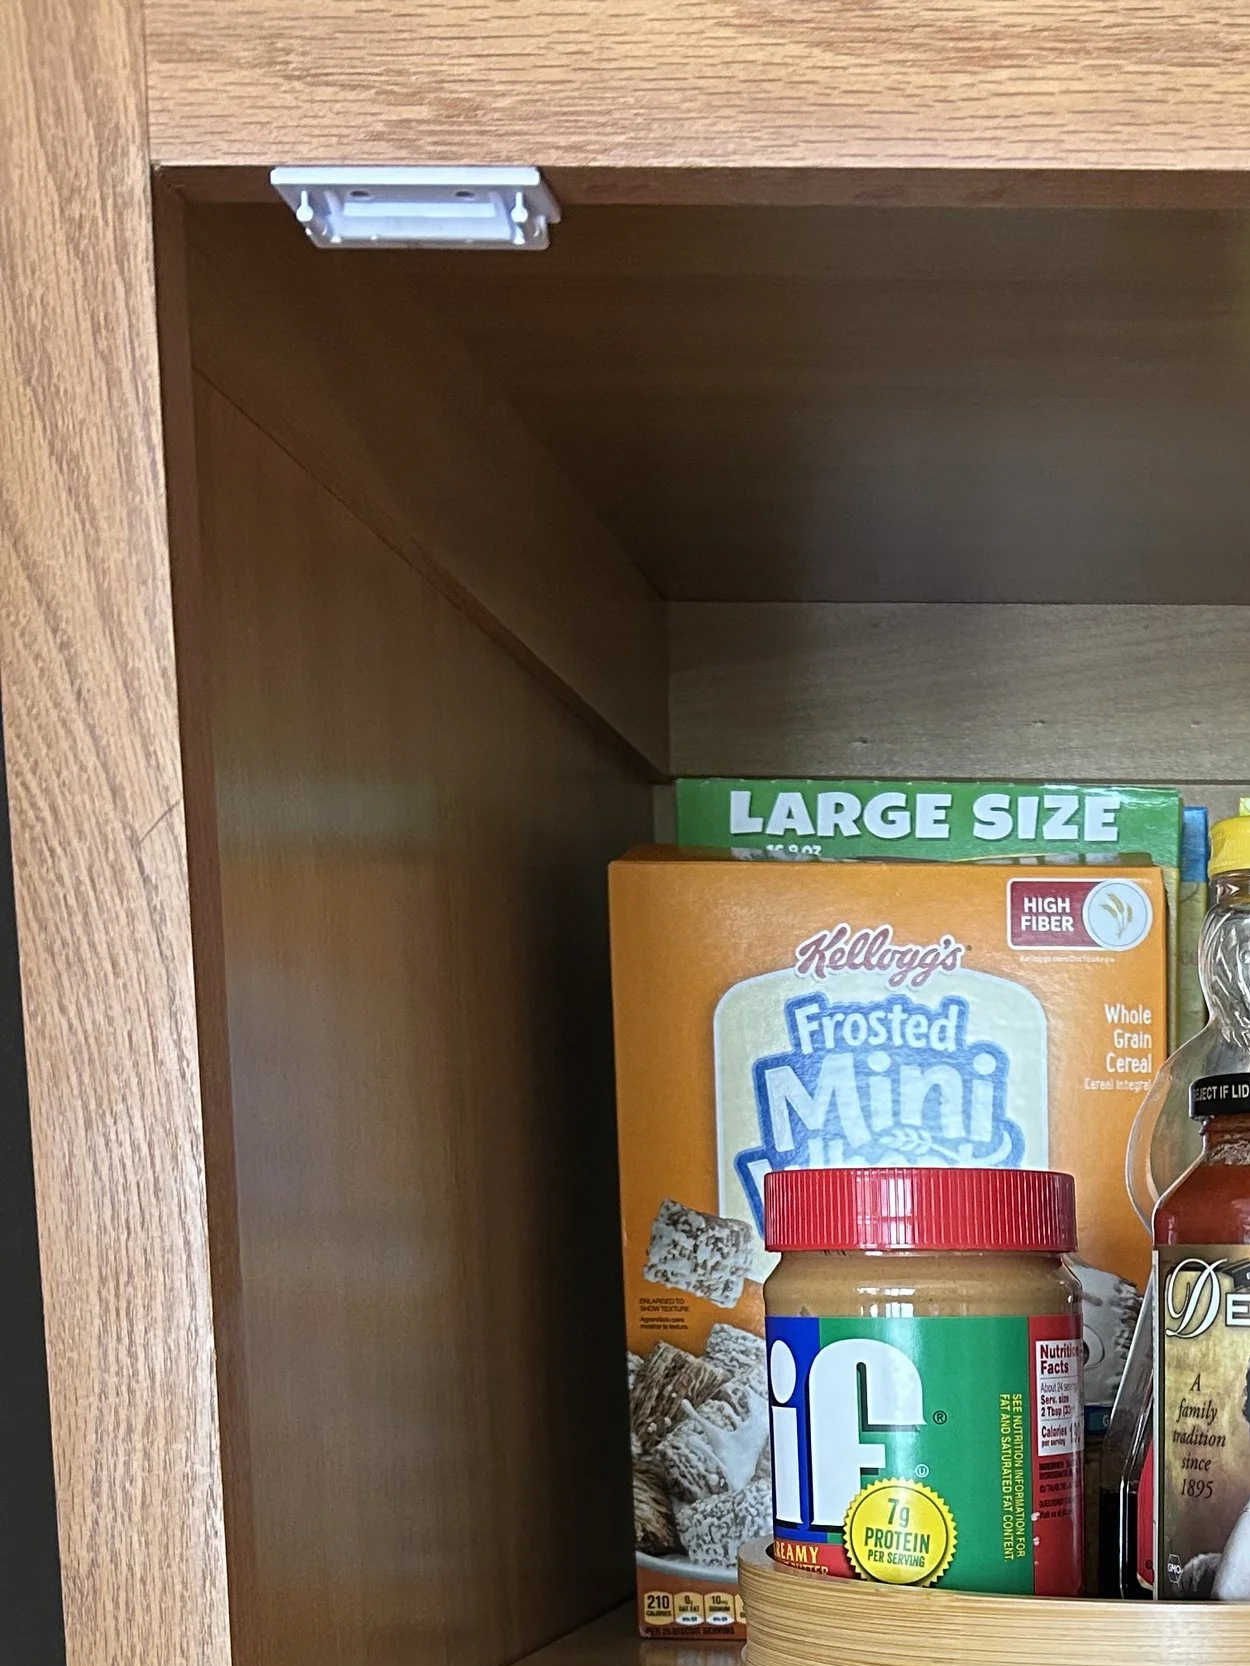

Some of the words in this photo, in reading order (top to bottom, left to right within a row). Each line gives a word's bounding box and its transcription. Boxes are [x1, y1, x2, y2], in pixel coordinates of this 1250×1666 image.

[729, 790, 952, 840] LARGE
[972, 792, 1122, 842] SIZE
[1023, 897, 1071, 913] HIGH
[1020, 915, 1075, 932] FIBER
[798, 926, 964, 987] Kellogg's
[1104, 1003, 1152, 1024] Whole
[799, 1004, 961, 1056] Frosted
[1113, 1029, 1152, 1049] Grain
[1106, 1053, 1152, 1073] Cereal
[1219, 1085, 1229, 1099] IF
[1231, 1083, 1250, 1098] LID
[764, 1050, 995, 1153] Mini
[1040, 1360, 1069, 1375] Facts
[1191, 1373, 1202, 1392] A
[1000, 1393, 1011, 1412] FAT
[1012, 1393, 1023, 1413] SEE
[1176, 1400, 1218, 1424] family
[1000, 1413, 1011, 1434] AND
[1041, 1425, 1068, 1438] Calories
[1012, 1415, 1024, 1467] NUTRITION
[1172, 1423, 1226, 1448] tradition
[1001, 1436, 1012, 1493] SATURATED
[1180, 1455, 1213, 1473] since
[1180, 1479, 1214, 1499] 1895
[1002, 1495, 1013, 1512] FAT
[1014, 1469, 1025, 1535] INFORMATION
[887, 1497, 911, 1528] 7g
[864, 1527, 930, 1555] PROTEIN
[1003, 1514, 1014, 1563] CONTENT.
[1016, 1537, 1025, 1557] FOR
[867, 1549, 884, 1563] PER
[886, 1551, 926, 1568] SERVING
[647, 1594, 670, 1609] 210
